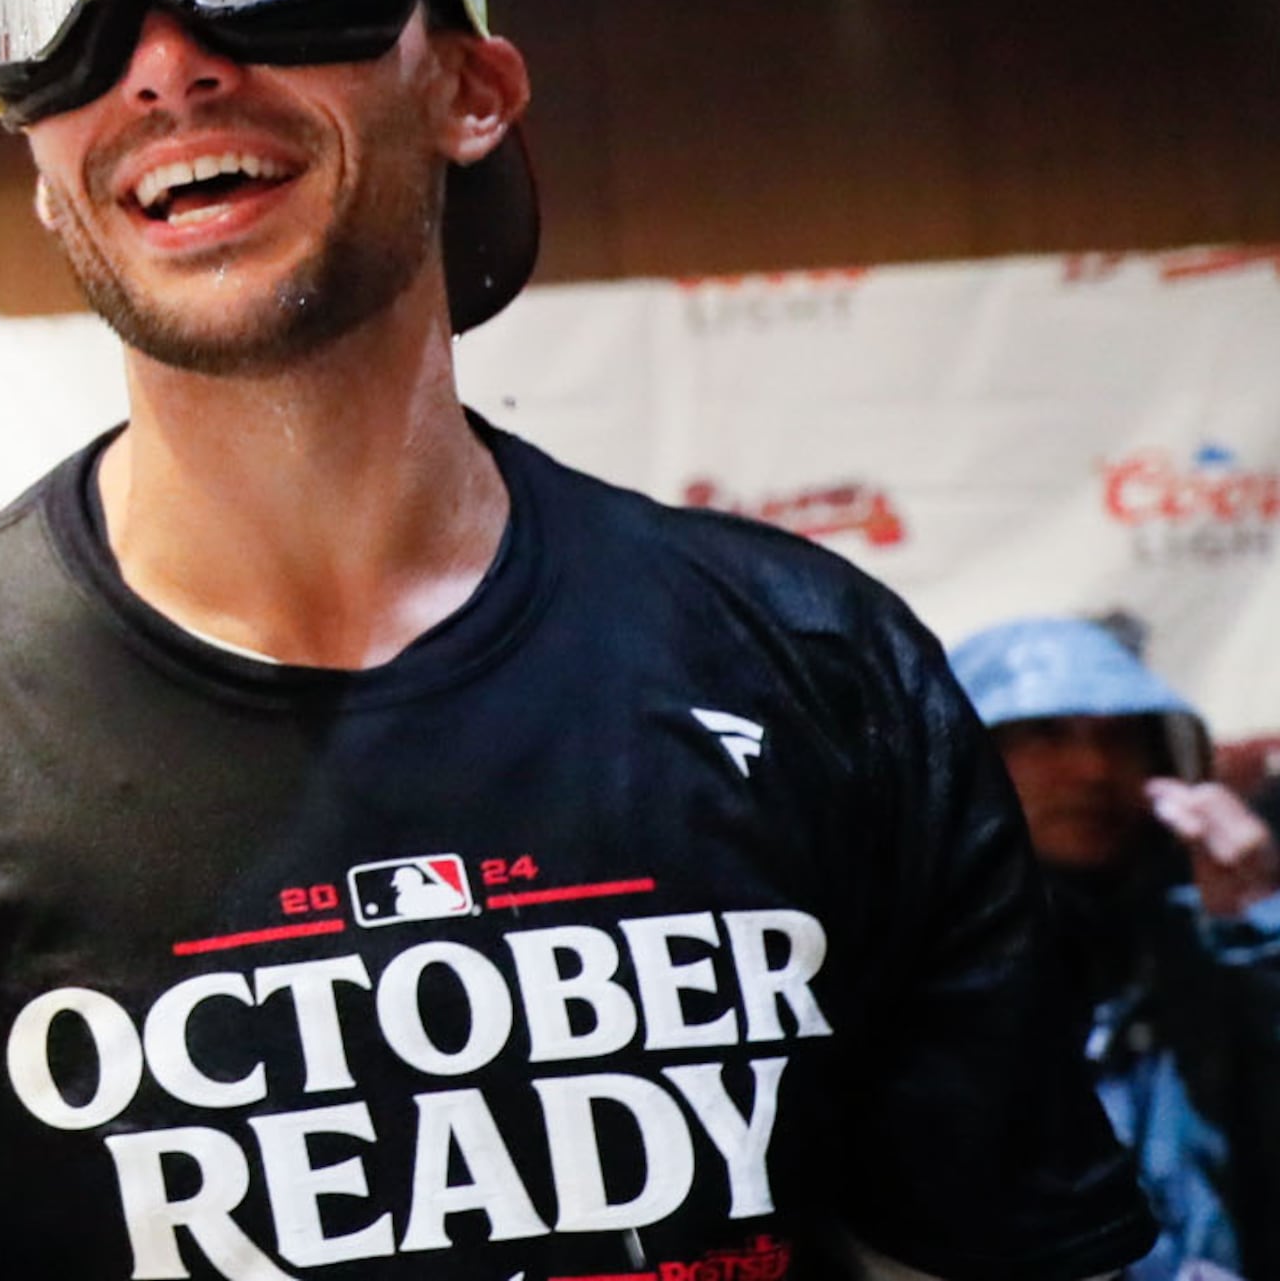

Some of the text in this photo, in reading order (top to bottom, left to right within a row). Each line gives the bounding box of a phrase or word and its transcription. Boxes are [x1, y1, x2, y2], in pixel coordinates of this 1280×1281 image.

[280, 883, 338, 915] 20
[480, 853, 539, 886] 24
[7, 909, 833, 1129] OCTOBER
[104, 1056, 789, 1281] READY
